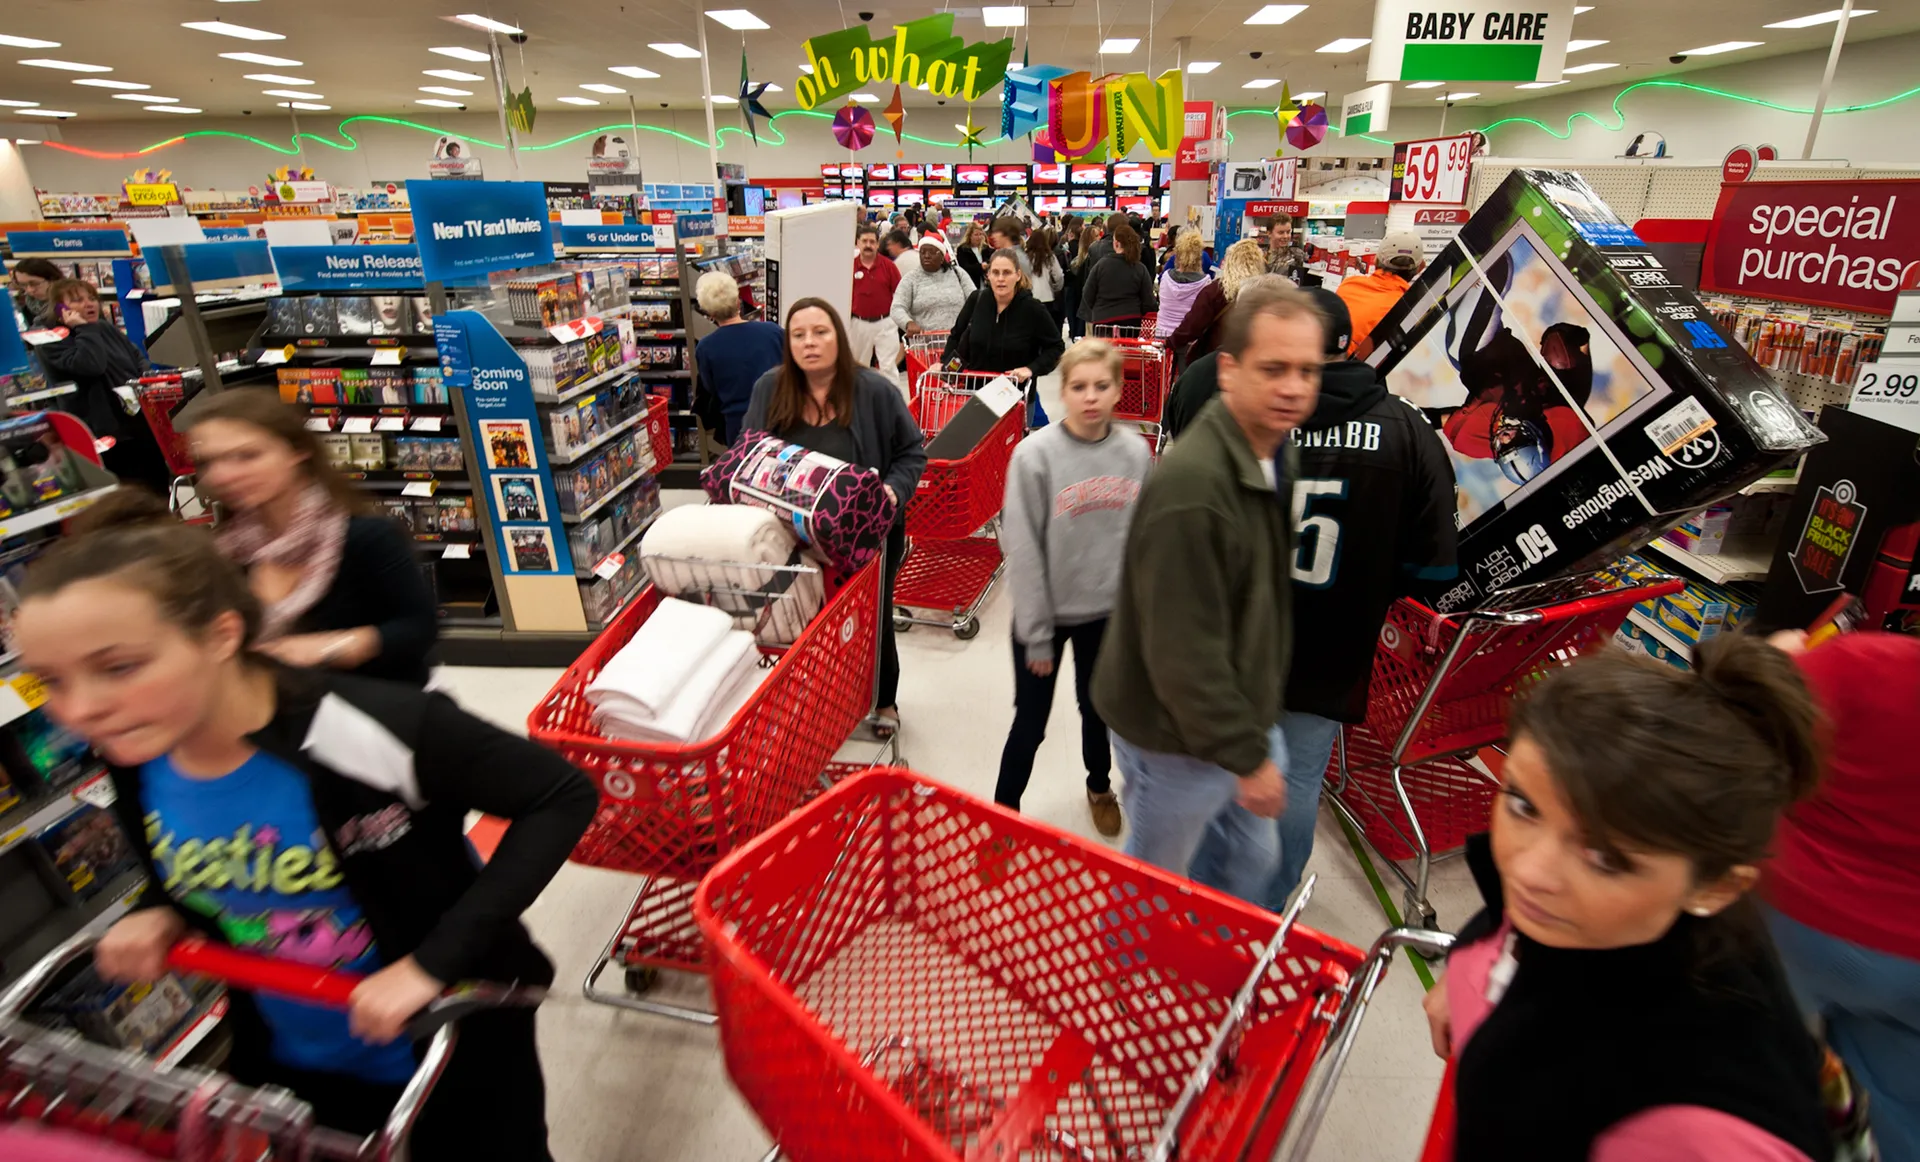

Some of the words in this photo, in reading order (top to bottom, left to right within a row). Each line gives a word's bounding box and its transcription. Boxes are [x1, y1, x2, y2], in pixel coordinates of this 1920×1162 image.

[1405, 12, 1476, 40] BABY
[1482, 12, 1549, 41] CARE
[794, 38, 840, 111] oh
[850, 24, 982, 103] what
[1001, 70, 1180, 158] FUN
[1185, 113, 1205, 121] PRICE
[1252, 205, 1299, 213] BATTERIES
[1418, 211, 1431, 223] A
[1433, 211, 1457, 223] 42
[1749, 195, 1897, 245] special
[432, 221, 464, 241] New
[464, 220, 483, 238] TV
[484, 218, 506, 237] and
[506, 217, 542, 235] Movies
[610, 233, 641, 243] Under
[1427, 228, 1440, 236] Baby
[52, 237, 83, 248] Drama
[325, 255, 360, 270] New
[1738, 243, 1905, 292] purchas
[470, 366, 524, 382] Coming
[472, 379, 509, 391] Soon
[1857, 372, 1919, 398] 2.99
[1854, 396, 1876, 404] Expect
[1894, 398, 1905, 406] Pay
[1562, 455, 1673, 530] Wesinghouse
[1290, 479, 1344, 585] 5
[1805, 526, 1848, 557] FRIDAY
[1810, 515, 1852, 546] BLACK
[1475, 544, 1510, 574] HDTV
[1488, 554, 1516, 577] LCD
[1801, 544, 1836, 580] SALE
[1614, 633, 1637, 652] always
